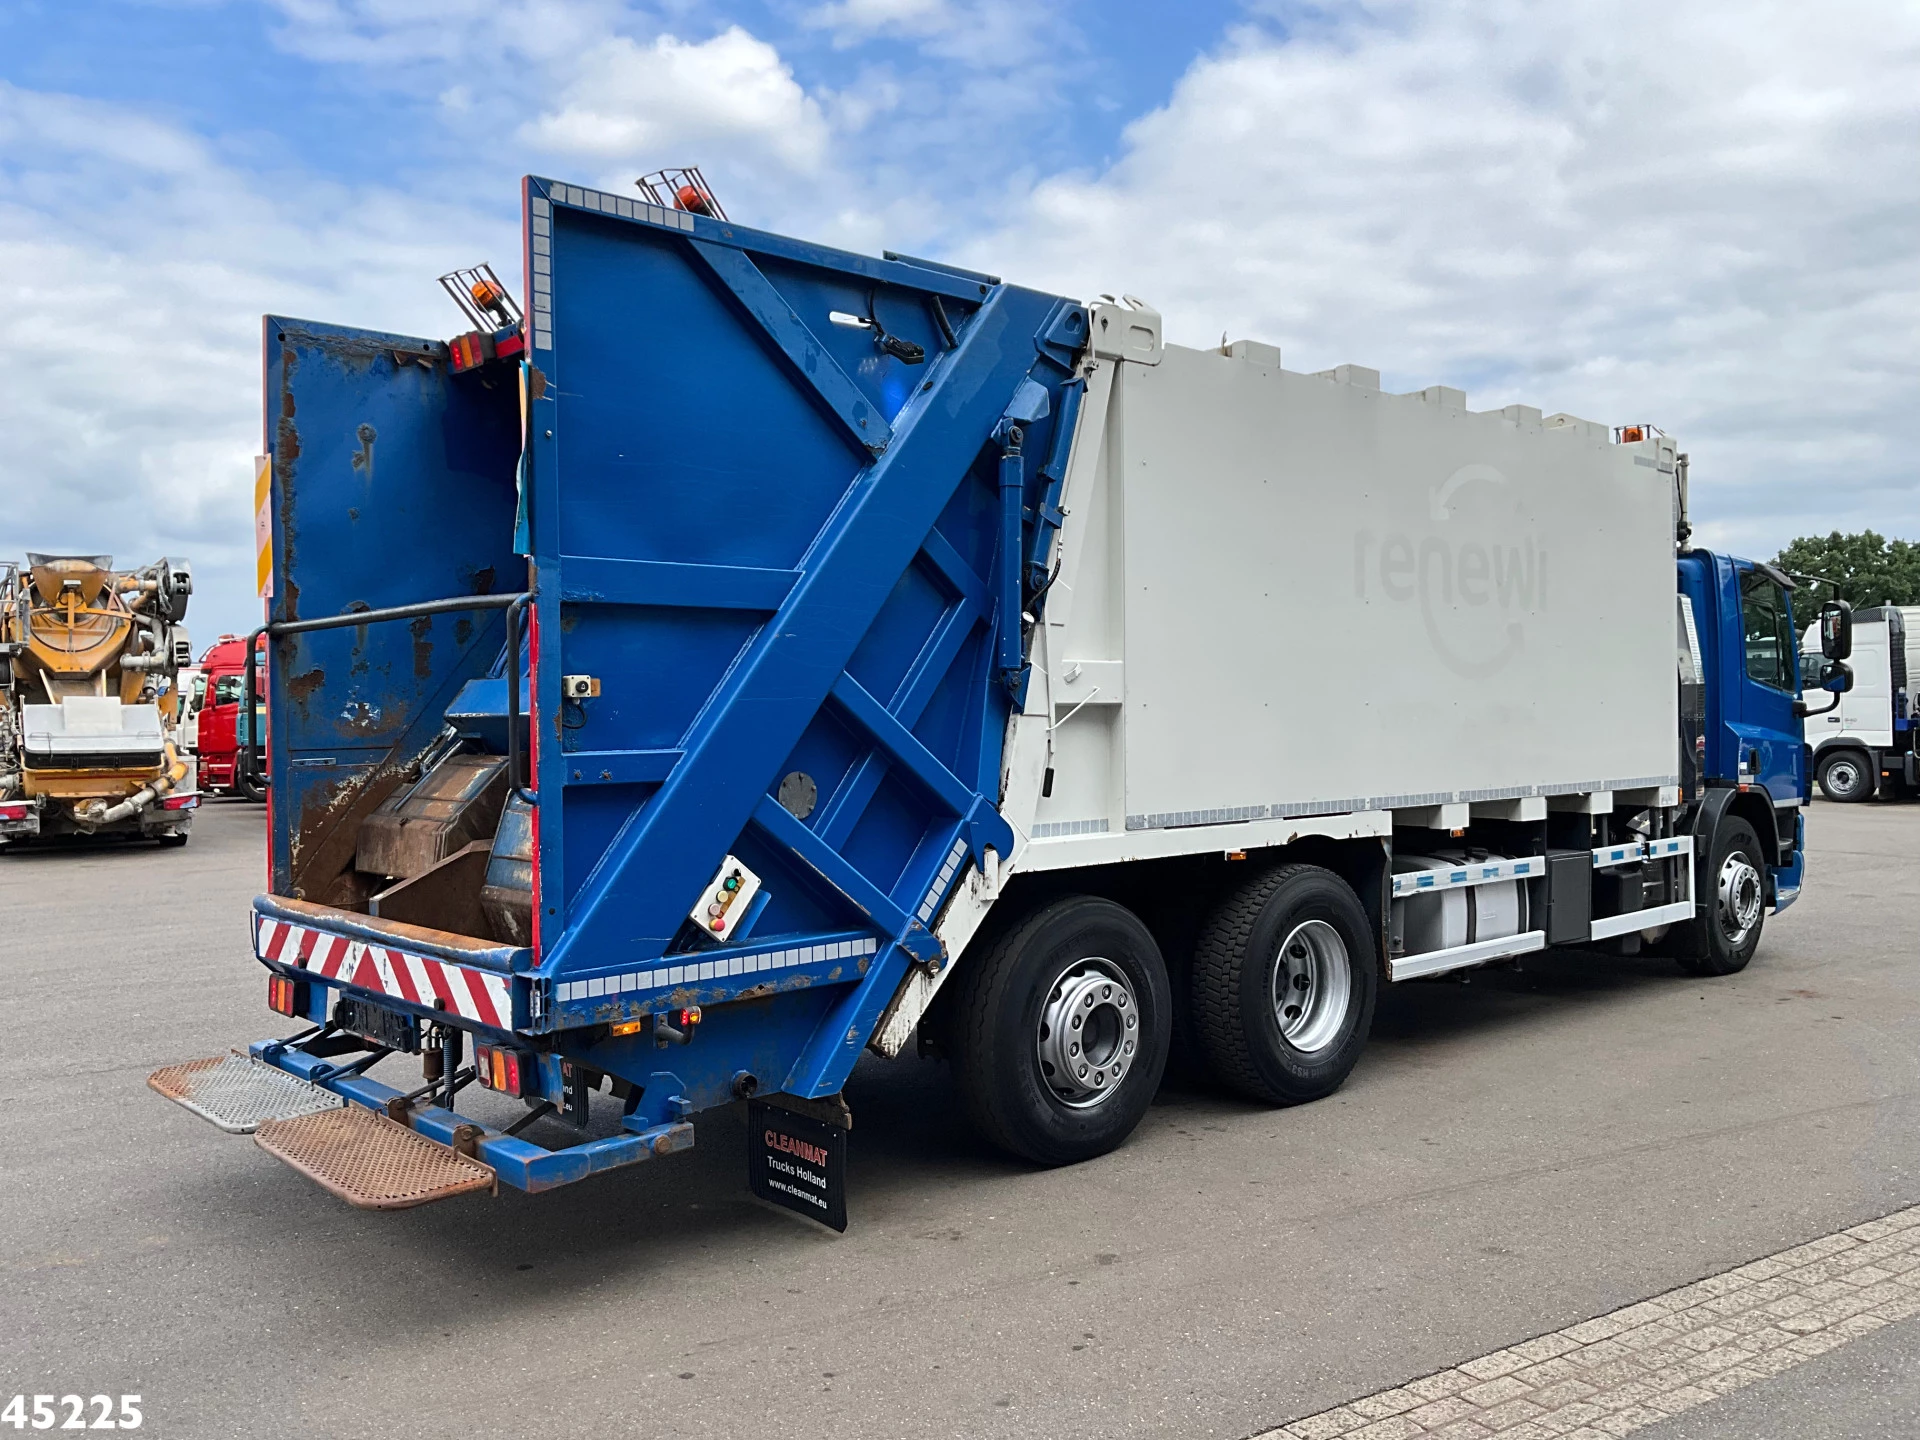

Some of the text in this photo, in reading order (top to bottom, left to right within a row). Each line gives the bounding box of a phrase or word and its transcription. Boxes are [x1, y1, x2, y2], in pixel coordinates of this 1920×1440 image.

[1354, 528, 1548, 613] renewi
[1292, 1064, 1309, 1079] HS3
[764, 1129, 828, 1167] CLEANMAT
[767, 1155, 827, 1189] Trucks Holland
[768, 1178, 828, 1210] www.cleanmat.eu
